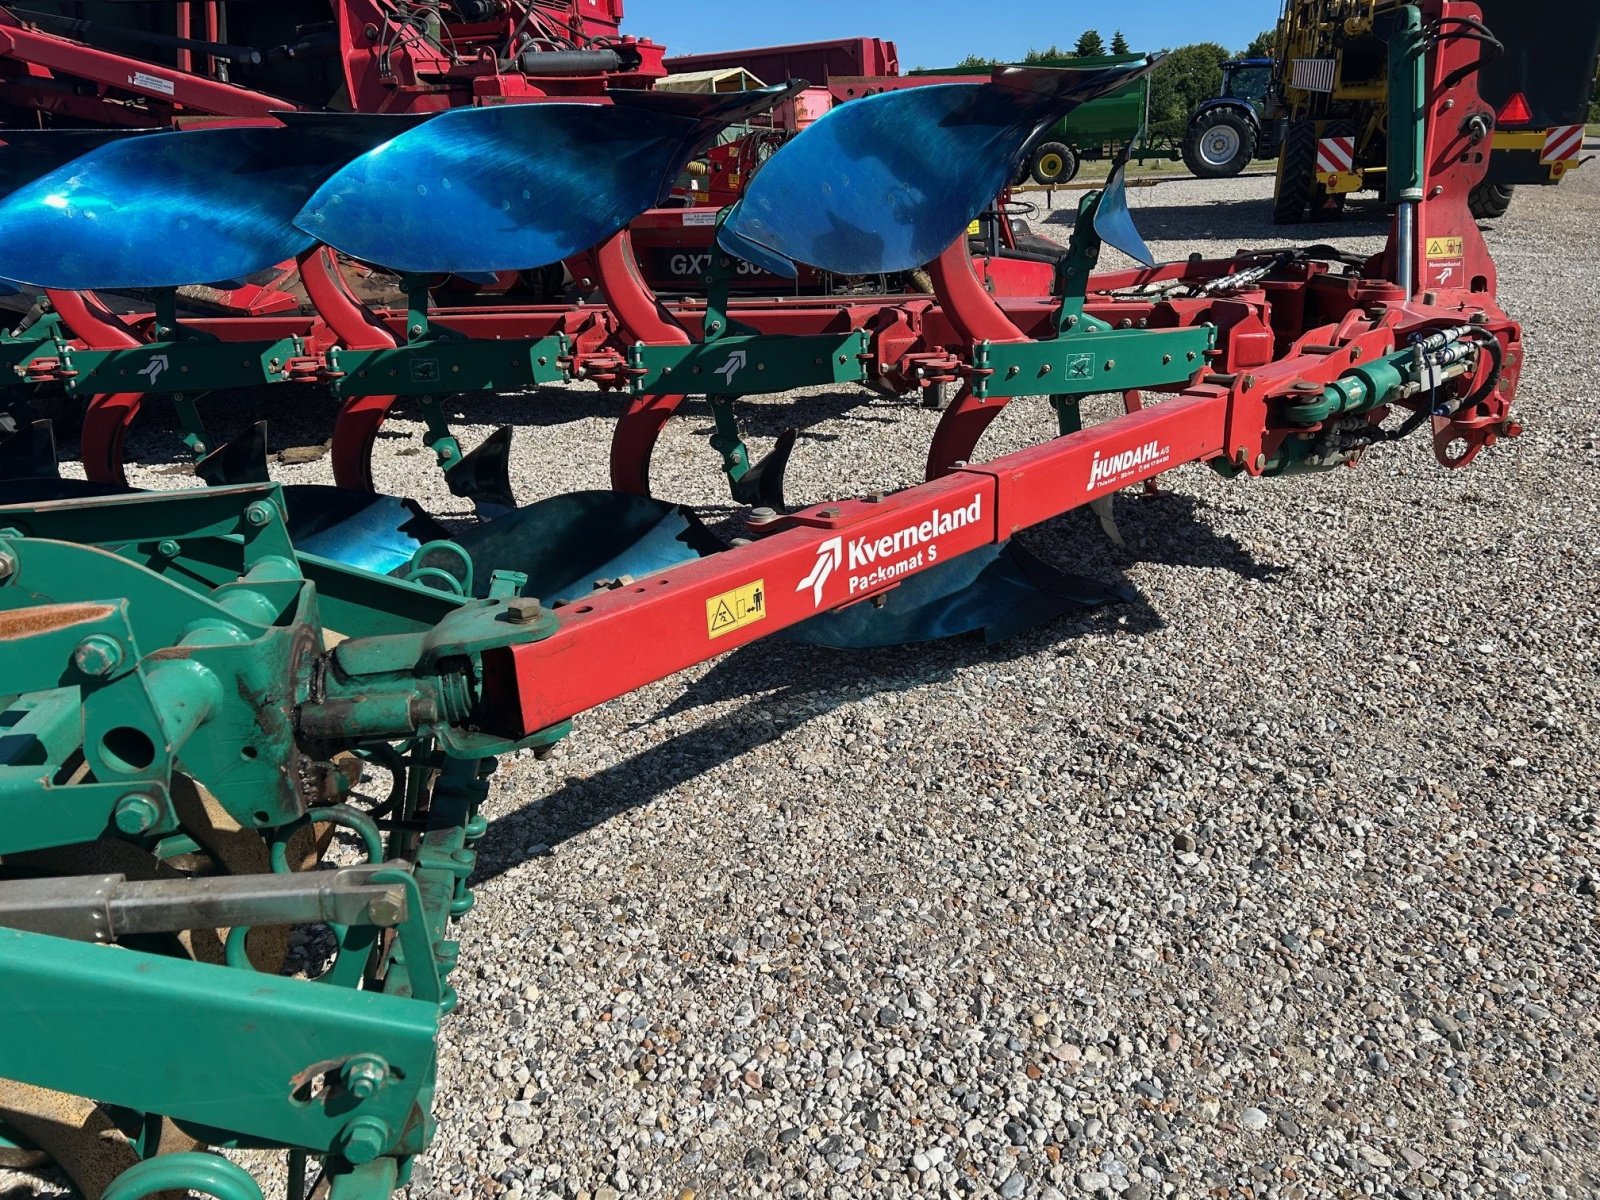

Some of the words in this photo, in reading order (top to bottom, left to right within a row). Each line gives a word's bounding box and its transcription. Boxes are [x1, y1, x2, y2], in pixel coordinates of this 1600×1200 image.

[1160, 446, 1170, 455] A/S
[1097, 477, 1116, 488] Thisted
[848, 493, 981, 571] Kverneland
[848, 550, 923, 594] Packomat
[928, 544, 937, 561] S
